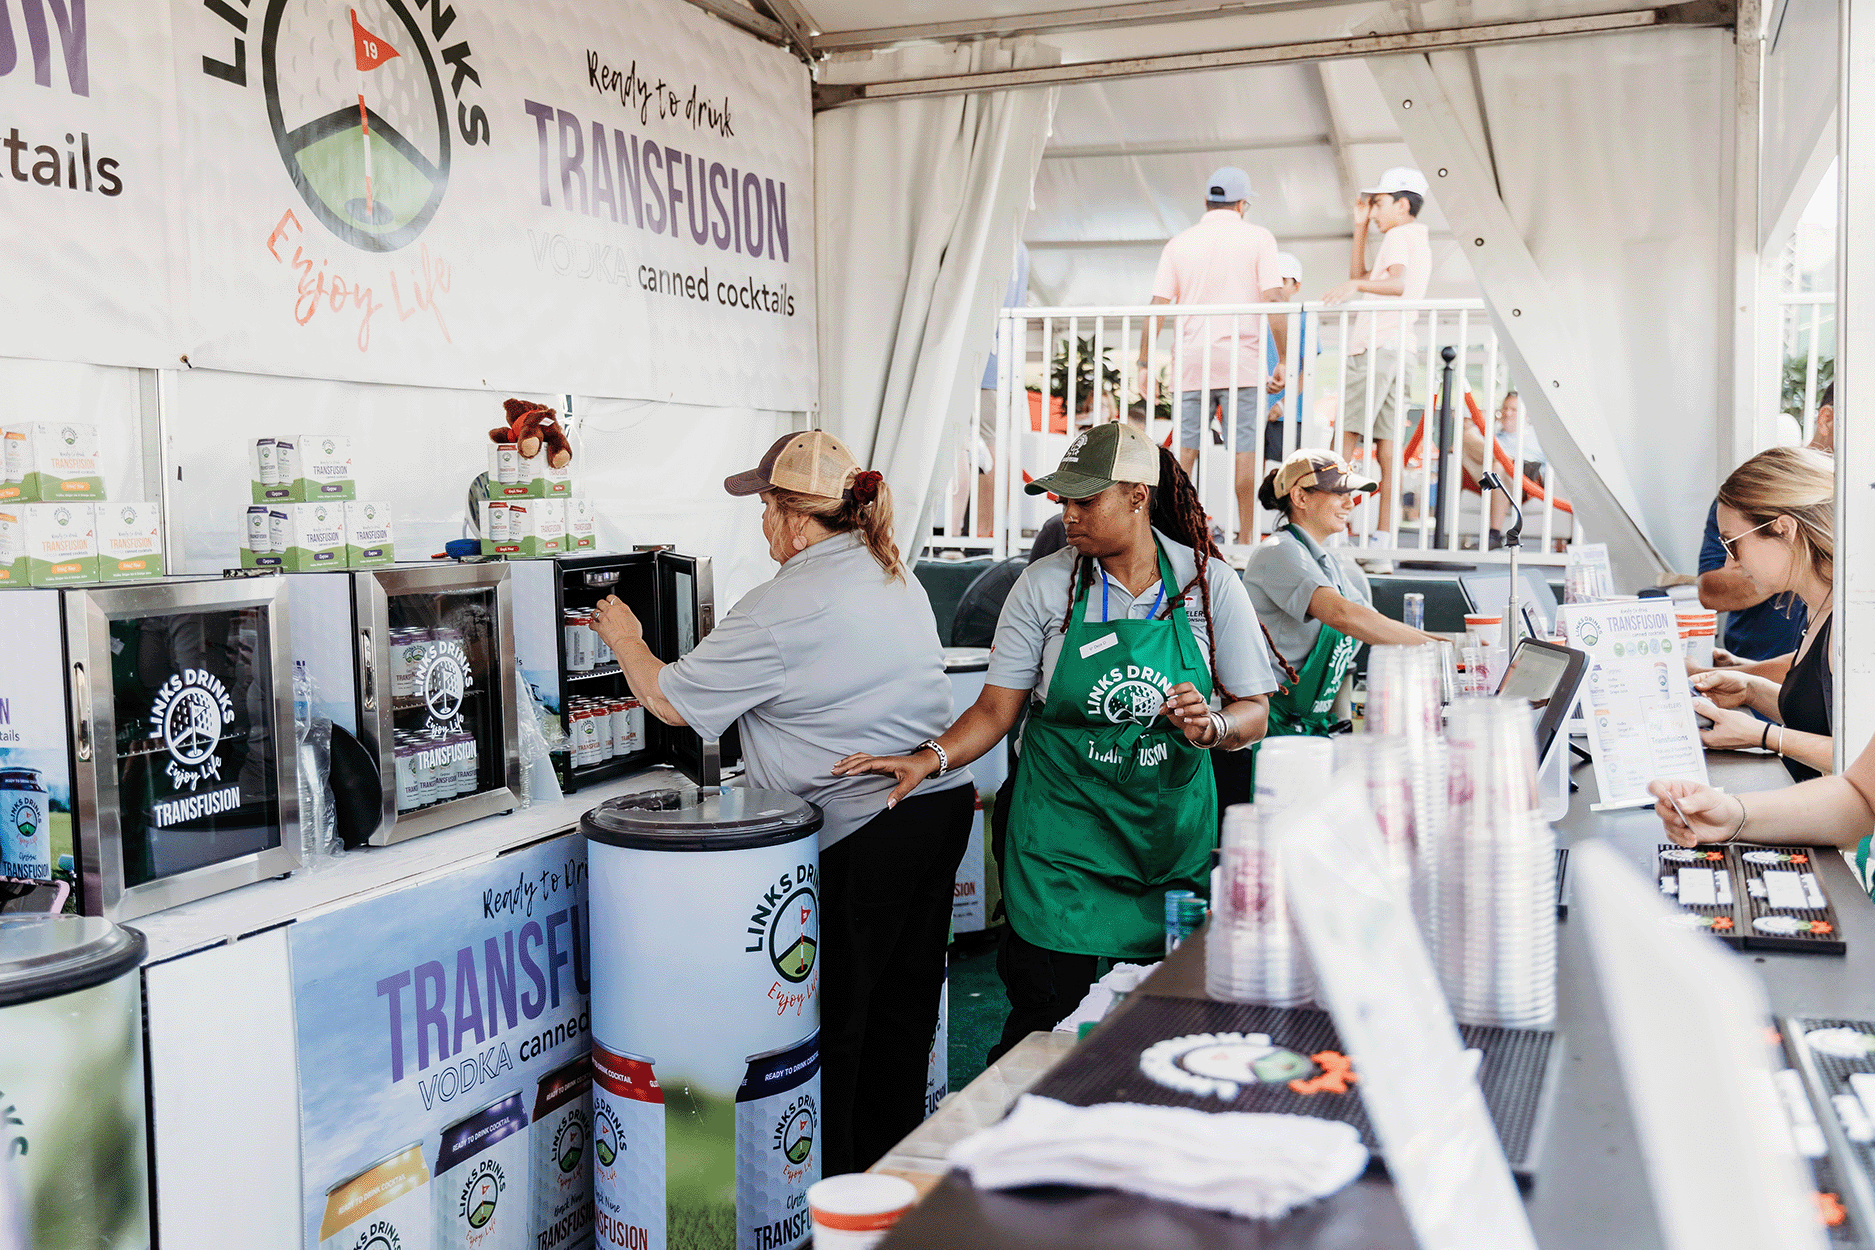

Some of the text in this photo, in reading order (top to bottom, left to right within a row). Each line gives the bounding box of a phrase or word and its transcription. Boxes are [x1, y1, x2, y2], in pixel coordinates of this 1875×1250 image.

[362, 39, 378, 60] 19
[587, 48, 734, 138] Ready to drink
[524, 99, 789, 263] TRANSFUSION
[267, 208, 453, 352] Enjoy Life
[638, 264, 709, 302] canned
[717, 275, 795, 317] cocktails
[51, 458, 96, 470] TRANSFUSION
[313, 465, 348, 475] TRANSFUSION
[42, 538, 88, 552] TRANSFUSION
[109, 537, 152, 549] TRANSFUSION
[306, 532, 339, 543] TRANSFUSION
[356, 530, 387, 540] TRANSFUSION
[1607, 613, 1669, 632] TRANSFUSION
[415, 641, 474, 697] LINKS DRINKS
[149, 668, 236, 739] LINKS DRINKS
[1087, 668, 1123, 715] LINKS
[165, 754, 222, 791] Enjoy Life
[417, 740, 478, 770] TRANSFUSION
[10, 799, 23, 823] LINKS
[154, 786, 241, 828] TRANSFUSION
[483, 872, 538, 919] Ready
[540, 870, 561, 901] to
[745, 873, 793, 952] LINKS
[767, 981, 806, 1016] Enjoy
[418, 1001, 590, 1111] VODKA canned
[764, 1069, 784, 1082] READY
[784, 1065, 793, 1075] TO
[793, 1060, 807, 1074] DRINK
[608, 1069, 632, 1084] COCKTAIL
[452, 1117, 511, 1153] READY TO DRINK COCKTAIL
[551, 1117, 567, 1162] LINKS
[600, 1098, 628, 1151] DRINKS
[772, 1103, 796, 1151] LINKS
[459, 1159, 506, 1218] LINKS DRINKS
[782, 1164, 803, 1184] Enjoy
